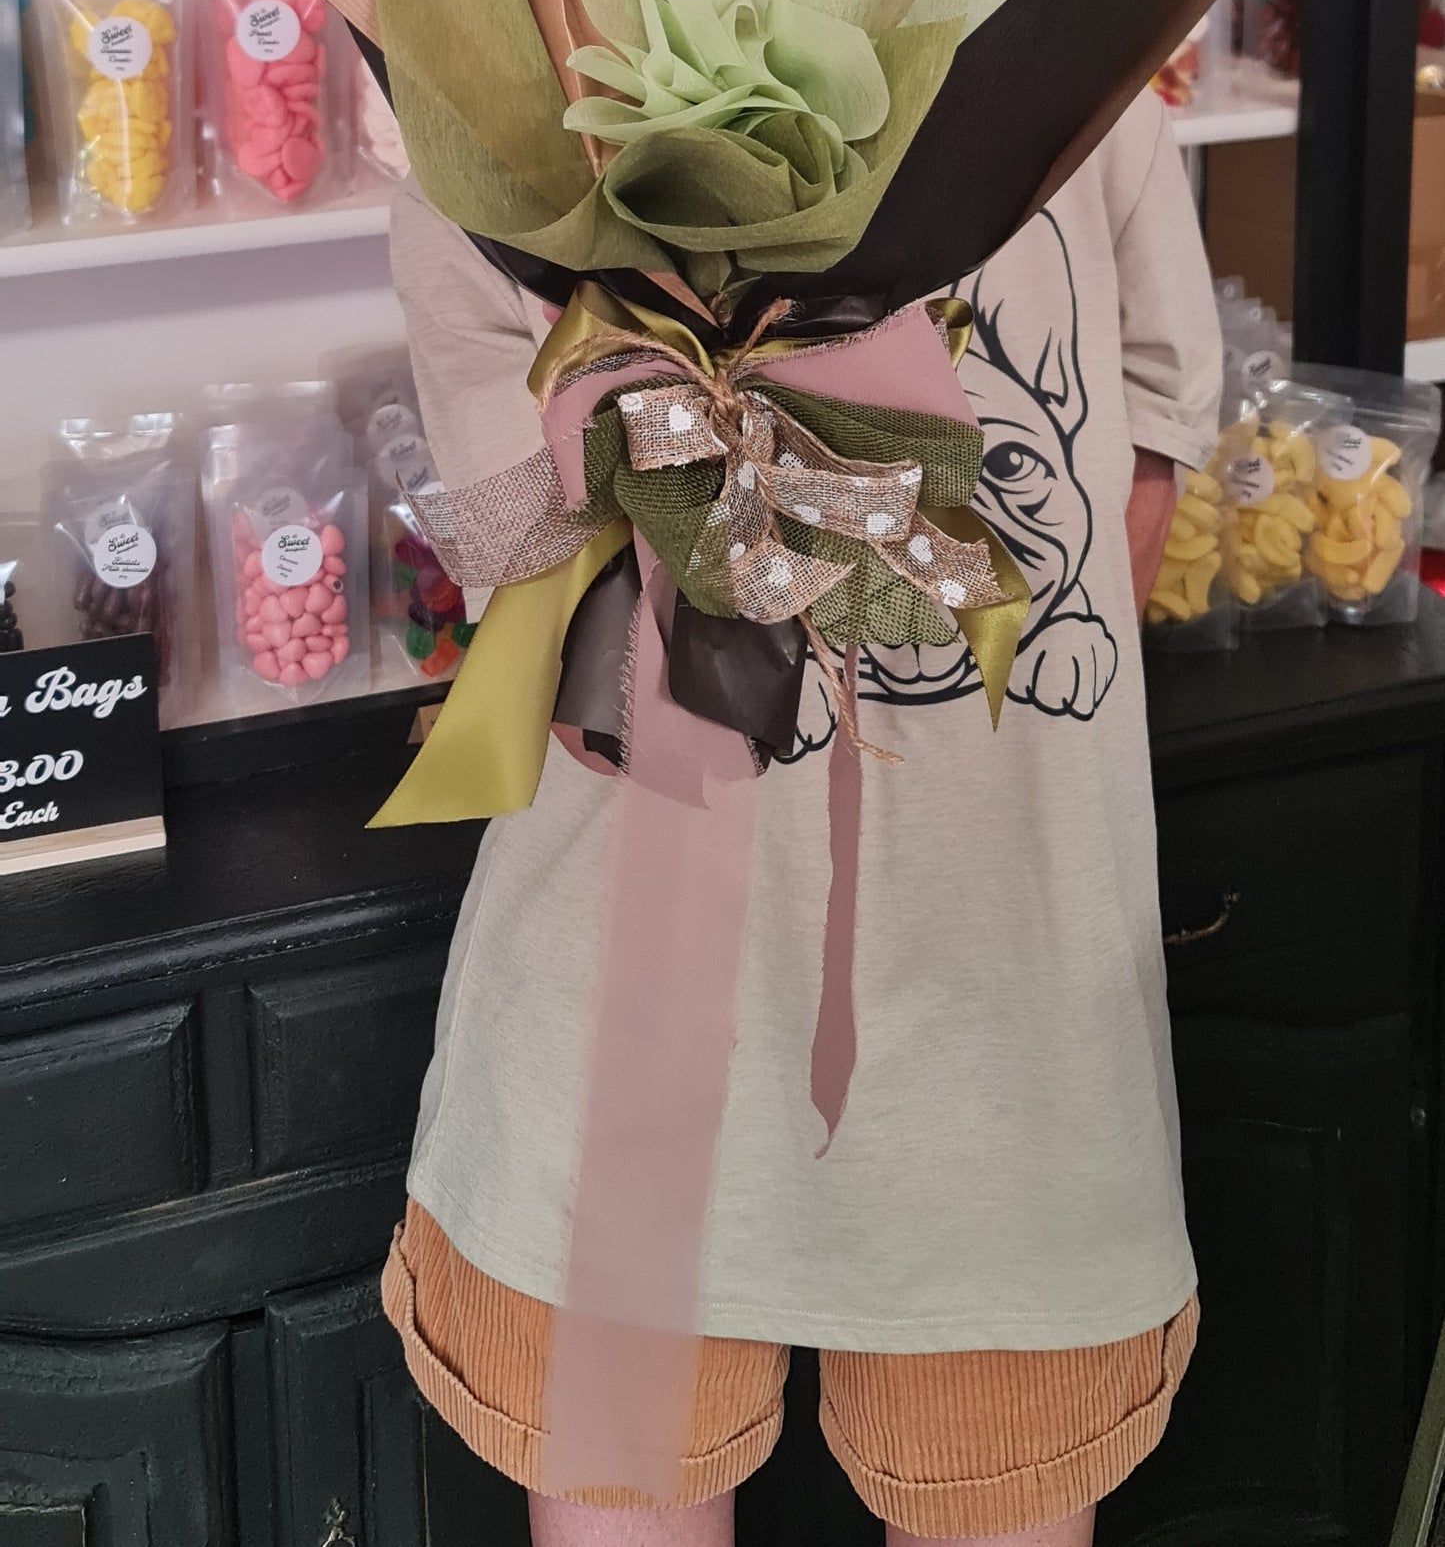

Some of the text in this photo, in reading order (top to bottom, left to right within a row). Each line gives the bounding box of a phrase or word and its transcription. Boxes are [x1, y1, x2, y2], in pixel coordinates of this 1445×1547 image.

[108, 532, 139, 552] Sweet
[278, 535, 311, 548] Sweet
[25, 666, 148, 719] Bags
[0, 801, 60, 830] Each
